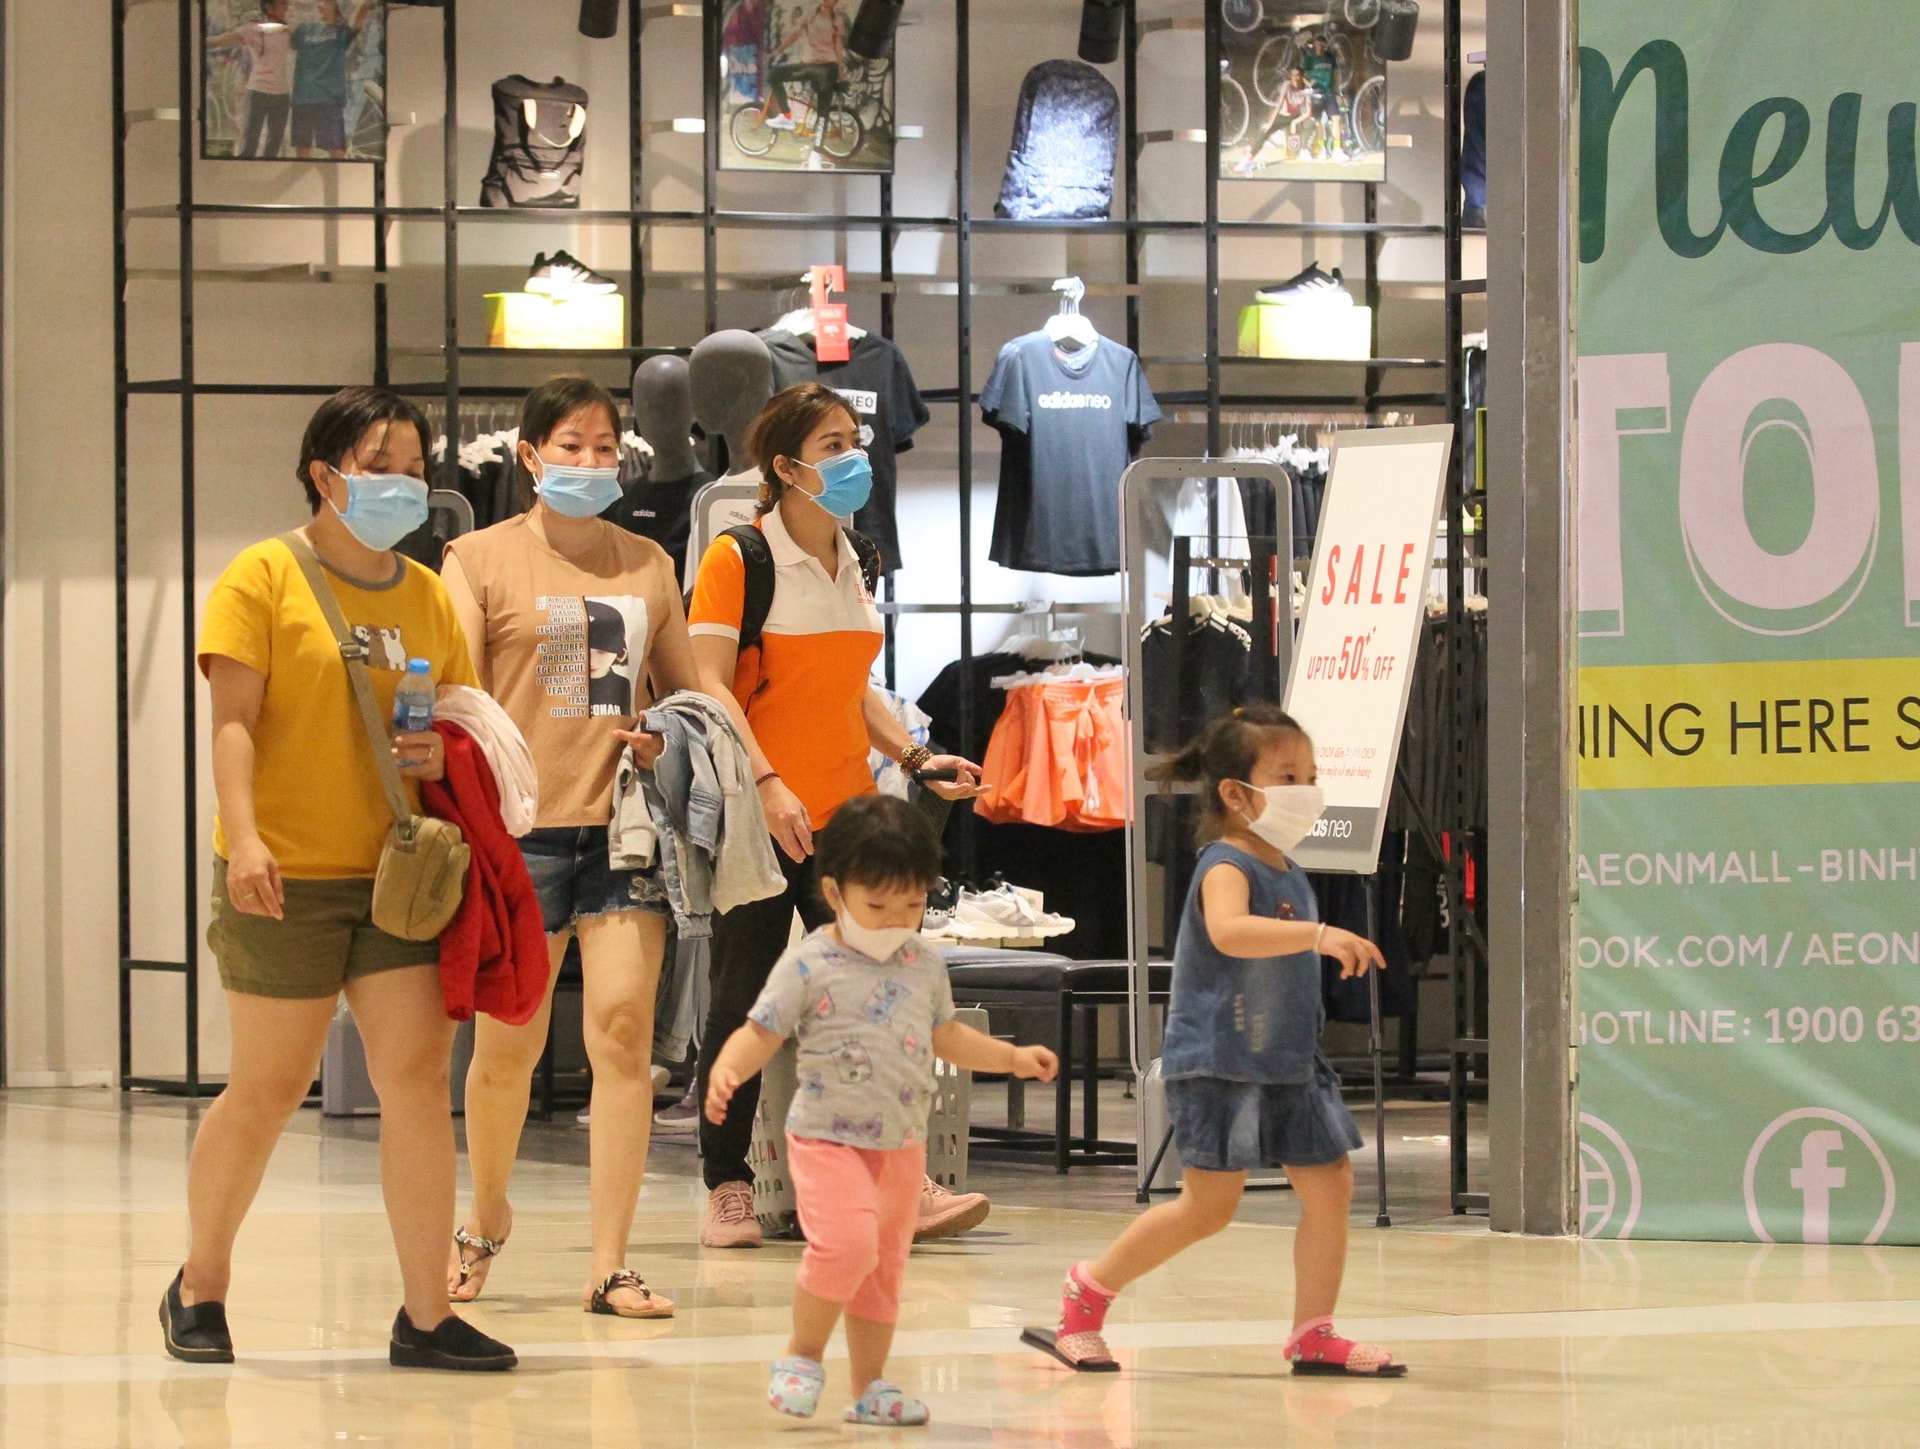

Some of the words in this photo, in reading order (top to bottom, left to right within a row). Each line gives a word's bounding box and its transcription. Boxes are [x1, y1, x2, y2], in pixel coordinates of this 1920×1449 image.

[1322, 543, 1415, 606] SALE
[537, 625, 568, 633] LEGENDS
[550, 643, 584, 652] OCTOBER
[543, 654, 585, 662] BROOKLYN
[555, 665, 585, 673] LEAGUE
[1373, 656, 1395, 680] OFF
[548, 687, 571, 695] TEAM
[552, 708, 585, 716] QUALITY
[1579, 703, 1704, 757] ING
[1730, 697, 1869, 755] HERE
[1764, 1006, 1864, 1043] 1900
